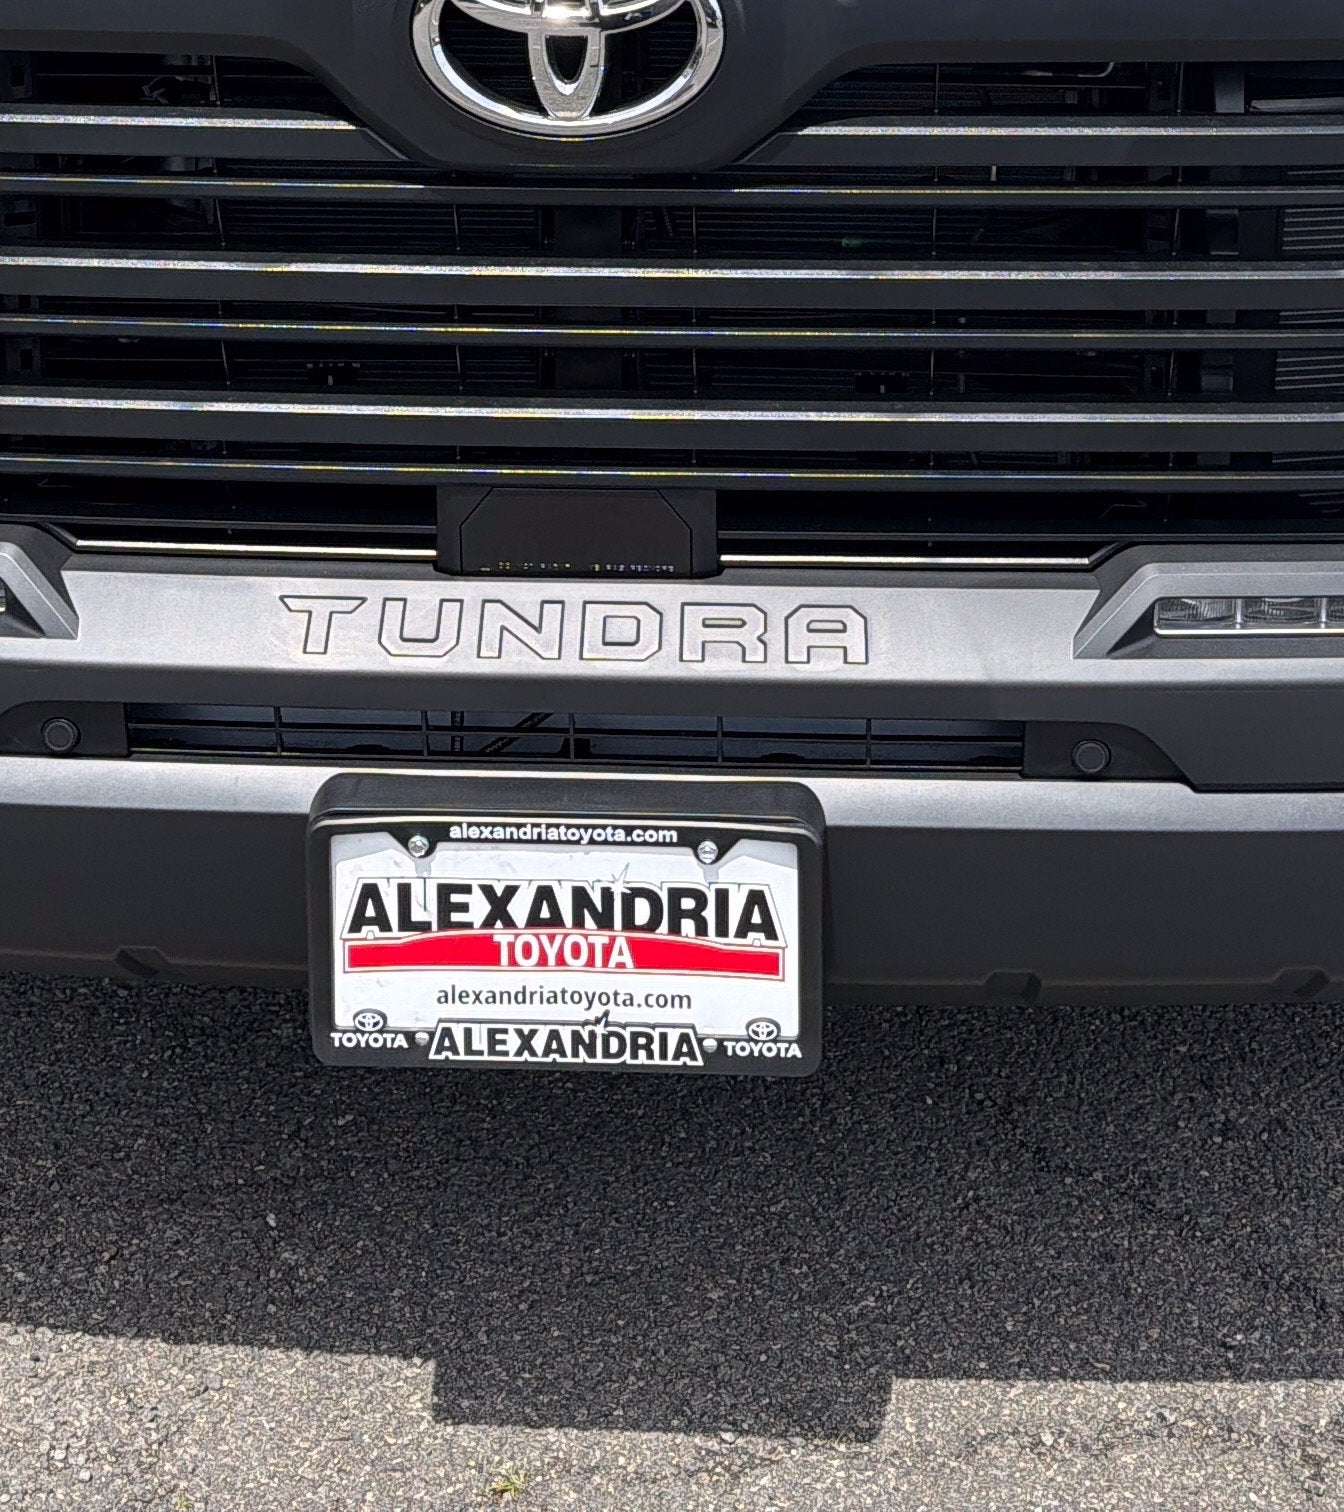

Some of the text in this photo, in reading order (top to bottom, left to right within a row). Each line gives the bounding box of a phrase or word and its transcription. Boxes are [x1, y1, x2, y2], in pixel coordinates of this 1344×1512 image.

[278, 594, 870, 665] TUNDRA
[449, 823, 678, 845] alexandriatoyota.com
[345, 882, 782, 941] ALEXANDRIA
[493, 933, 635, 969] TOYOTA
[436, 984, 693, 1011] alexandriatoyota.com
[330, 1024, 803, 1065] TOYOTA ALEXANDRIA TOYOTA
